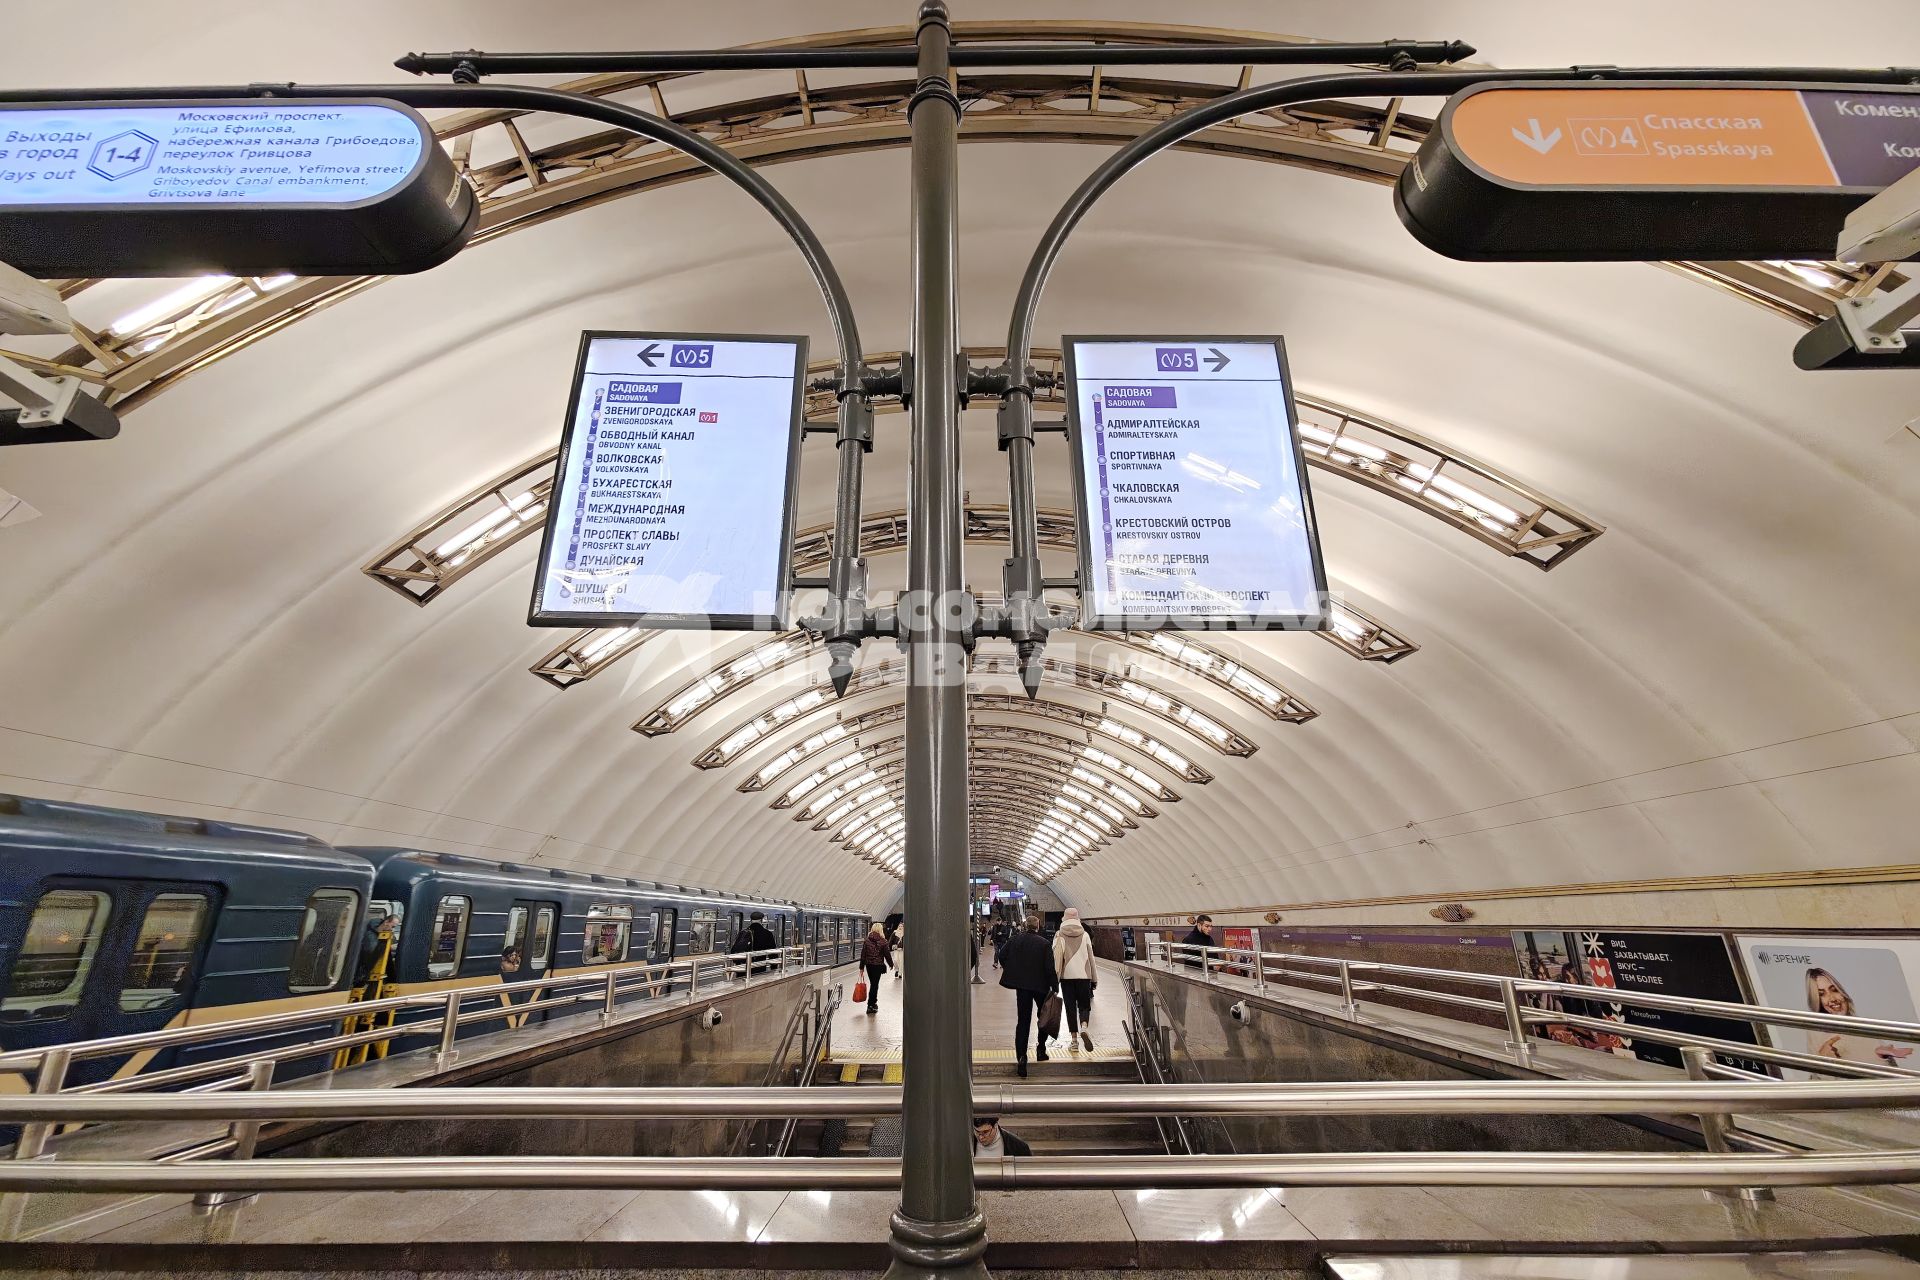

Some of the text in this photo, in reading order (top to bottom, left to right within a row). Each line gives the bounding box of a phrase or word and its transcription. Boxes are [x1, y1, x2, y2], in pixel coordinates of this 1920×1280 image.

[178, 111, 269, 121] Московский
[1644, 113, 1764, 130] Спасская
[173, 124, 295, 135] улица Ефимова,
[5, 130, 92, 143] Выходы
[168, 137, 261, 147] набережная
[325, 136, 419, 147] Грибоедова,
[16, 148, 79, 161] город
[105, 146, 141, 163] 1-4
[163, 149, 312, 160] переулок Гривцова
[1653, 140, 1774, 160] Spasskaya
[43, 169, 76, 180] out
[157, 165, 407, 175] Moskovskiy avenue, Yefimova street,
[153, 176, 369, 187] Griboyedov Canal embankment,
[148, 189, 245, 198] Grivtsova lane
[610, 383, 659, 394] САДОВАЯ
[1106, 388, 1153, 398] САДОВАЯ
[609, 393, 648, 402] SADOVAYA
[1107, 399, 1146, 407] SADOVAYA
[604, 406, 697, 418] ЗВЕНИГОРОДСКАЯ
[602, 417, 674, 426] ZVENIGORODSKAYA
[1107, 418, 1200, 429] АДМИРАЛТЕЙСКАЯ
[600, 429, 695, 441] ОБВОДНЫЙ КАНАЛ
[1108, 431, 1178, 439] ADMIRALTEYSKAYA
[598, 441, 662, 450] OBVODNY KANAL
[596, 453, 664, 464] ВОЛКОВСКАЯ
[1110, 451, 1176, 460] СПОРТИВНАЯ
[595, 465, 649, 473] VOLKOVSKAYA
[592, 478, 673, 489] БУХАРЕСТСКАЯ
[1112, 483, 1180, 493] ЧКАЛОВСКАЯ
[590, 490, 662, 499] BUKHARESTSKAYA
[1113, 496, 1173, 504] CHKALOVSKAYA
[588, 503, 686, 516] МЕЖДУНАРОДНАЯ
[586, 515, 666, 524] MEZHDUNARODNAYA
[1115, 516, 1231, 528] КРЕСТОВСКИЙ ОСТРОВ
[583, 529, 680, 541] ПРОСПЕКТ СЛАВЫ
[1116, 531, 1201, 539] KRESTOVSKIY OSTROV
[582, 541, 652, 551] PROSPEKT SLAVY
[579, 554, 645, 567] ДУНАЙСКАЯ
[1118, 554, 1210, 565] СТАРАЯ ДЕРЕВНЯ
[574, 583, 628, 595] ШУШАЫ
[1122, 605, 1189, 613] KOMENDANTSKIY
[1610, 940, 1627, 949] ВИД
[1613, 951, 1673, 962] ЗАХВАТЫВАЕТ.
[1772, 954, 1812, 965] ЗРЕНИЕ
[1617, 962, 1638, 971] ВКУС
[1620, 973, 1664, 985] ТЕМ БОЛЕЕ
